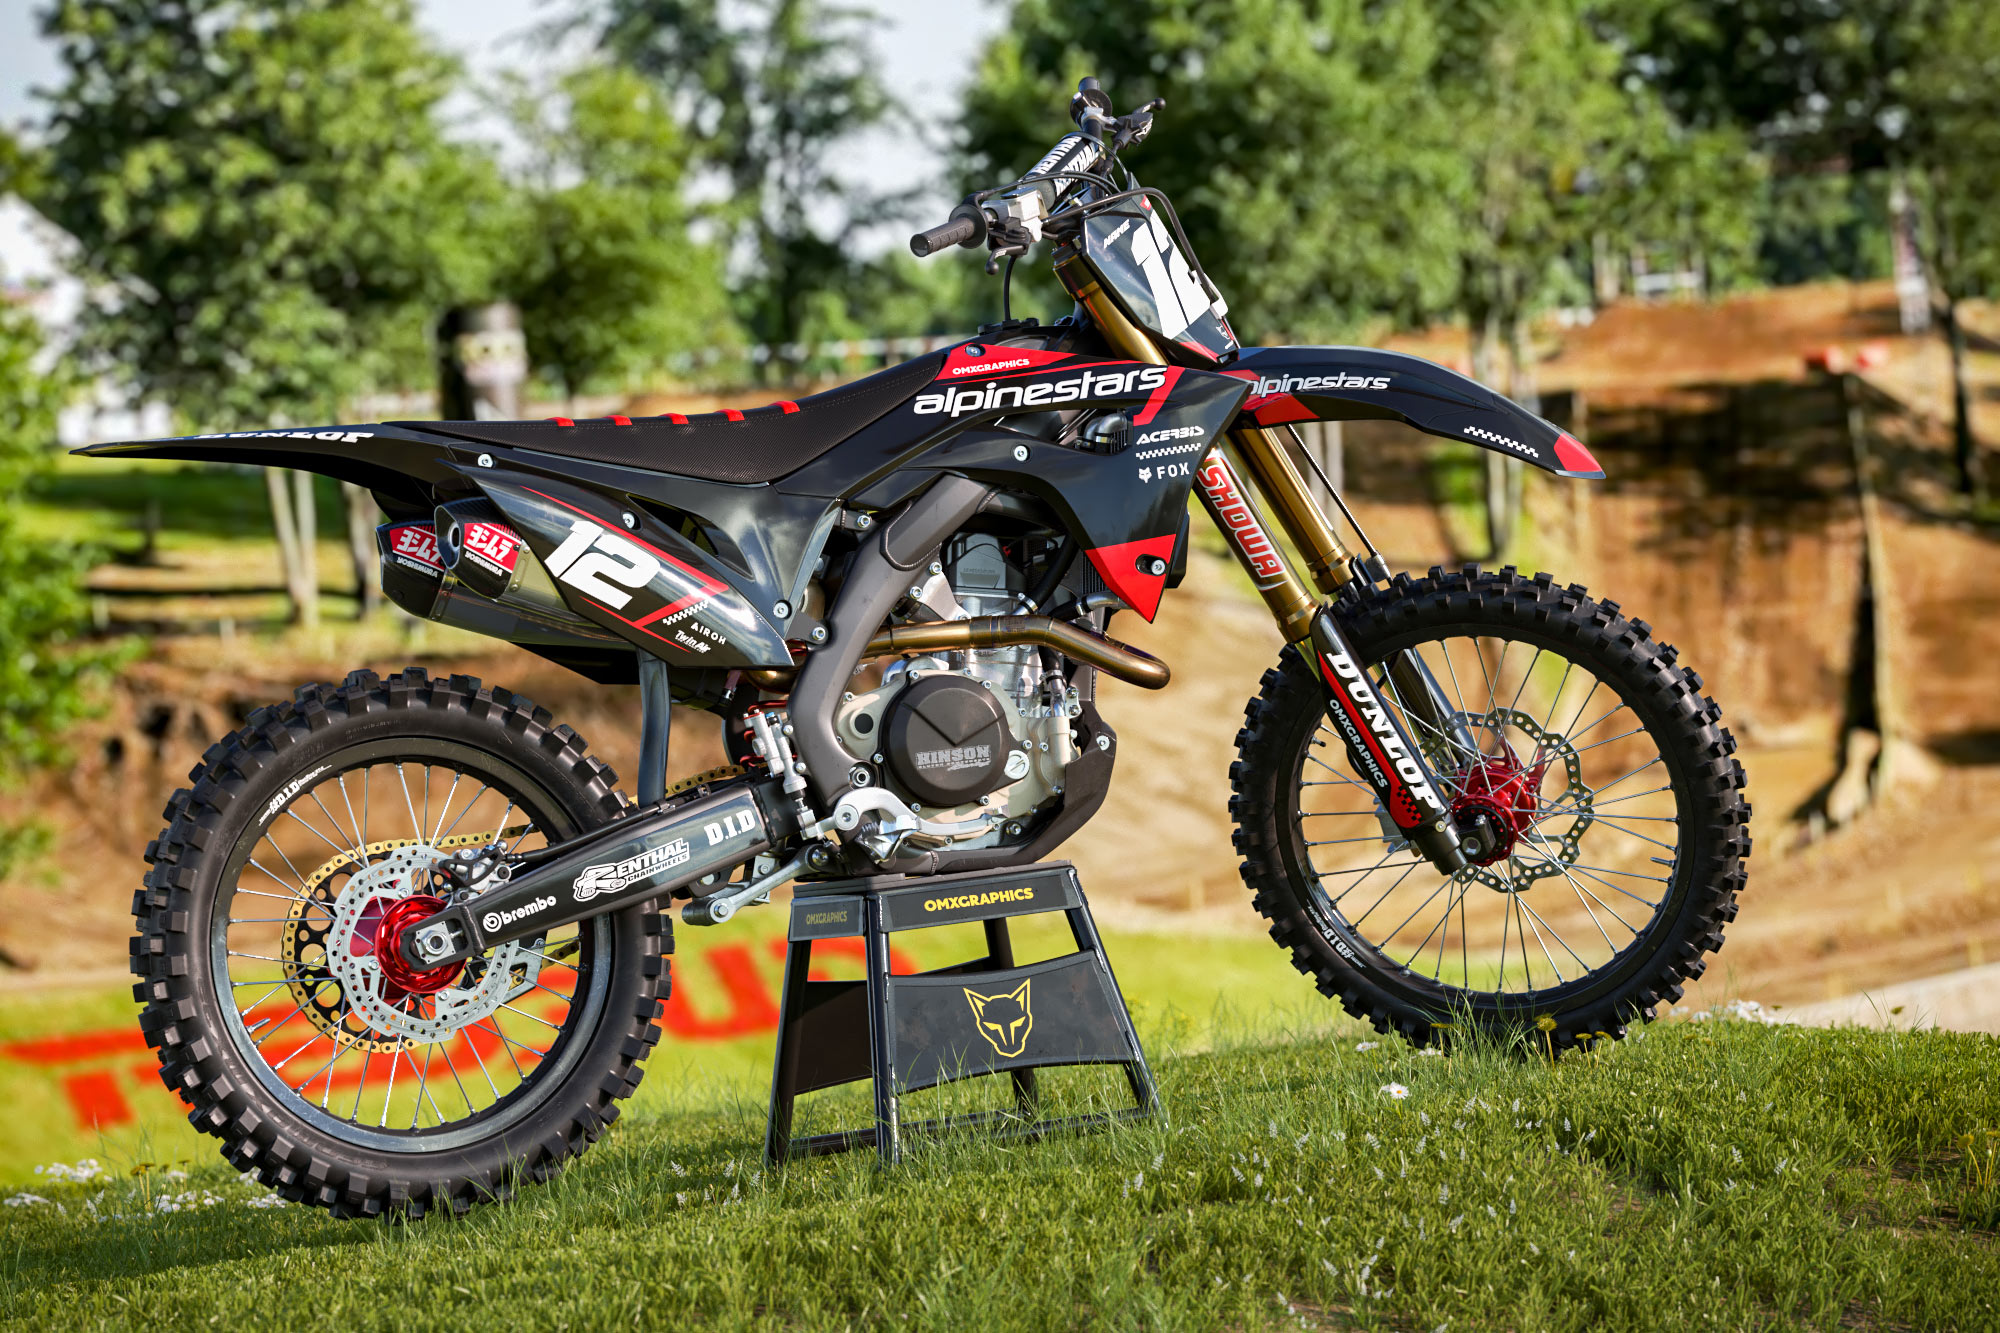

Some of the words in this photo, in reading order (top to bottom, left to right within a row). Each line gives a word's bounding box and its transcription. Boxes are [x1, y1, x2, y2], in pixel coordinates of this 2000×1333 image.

[1104, 219, 1130, 249] NAME
[952, 358, 1030, 375] OMXGRAPHICS
[914, 367, 1168, 417] alpinestars
[194, 431, 375, 443] DUNLOP
[1157, 462, 1190, 480] FOX
[1196, 464, 1286, 579] SHOWA
[396, 556, 438, 578] YOSHIMURA
[465, 551, 503, 576] YOSHIMURA
[544, 520, 661, 611] 12
[691, 622, 727, 645] AIROH
[1325, 650, 1447, 814] DUNLOP
[1329, 699, 1388, 788] OMXGRAPHICS
[916, 745, 990, 766] HINSON
[704, 809, 757, 846] D.I.D
[628, 854, 688, 882] CHAINWHEELS
[500, 895, 557, 926] brembo
[924, 887, 1034, 912] OMXGRAPHICS
[805, 911, 848, 926] OMXGRAPHICS
